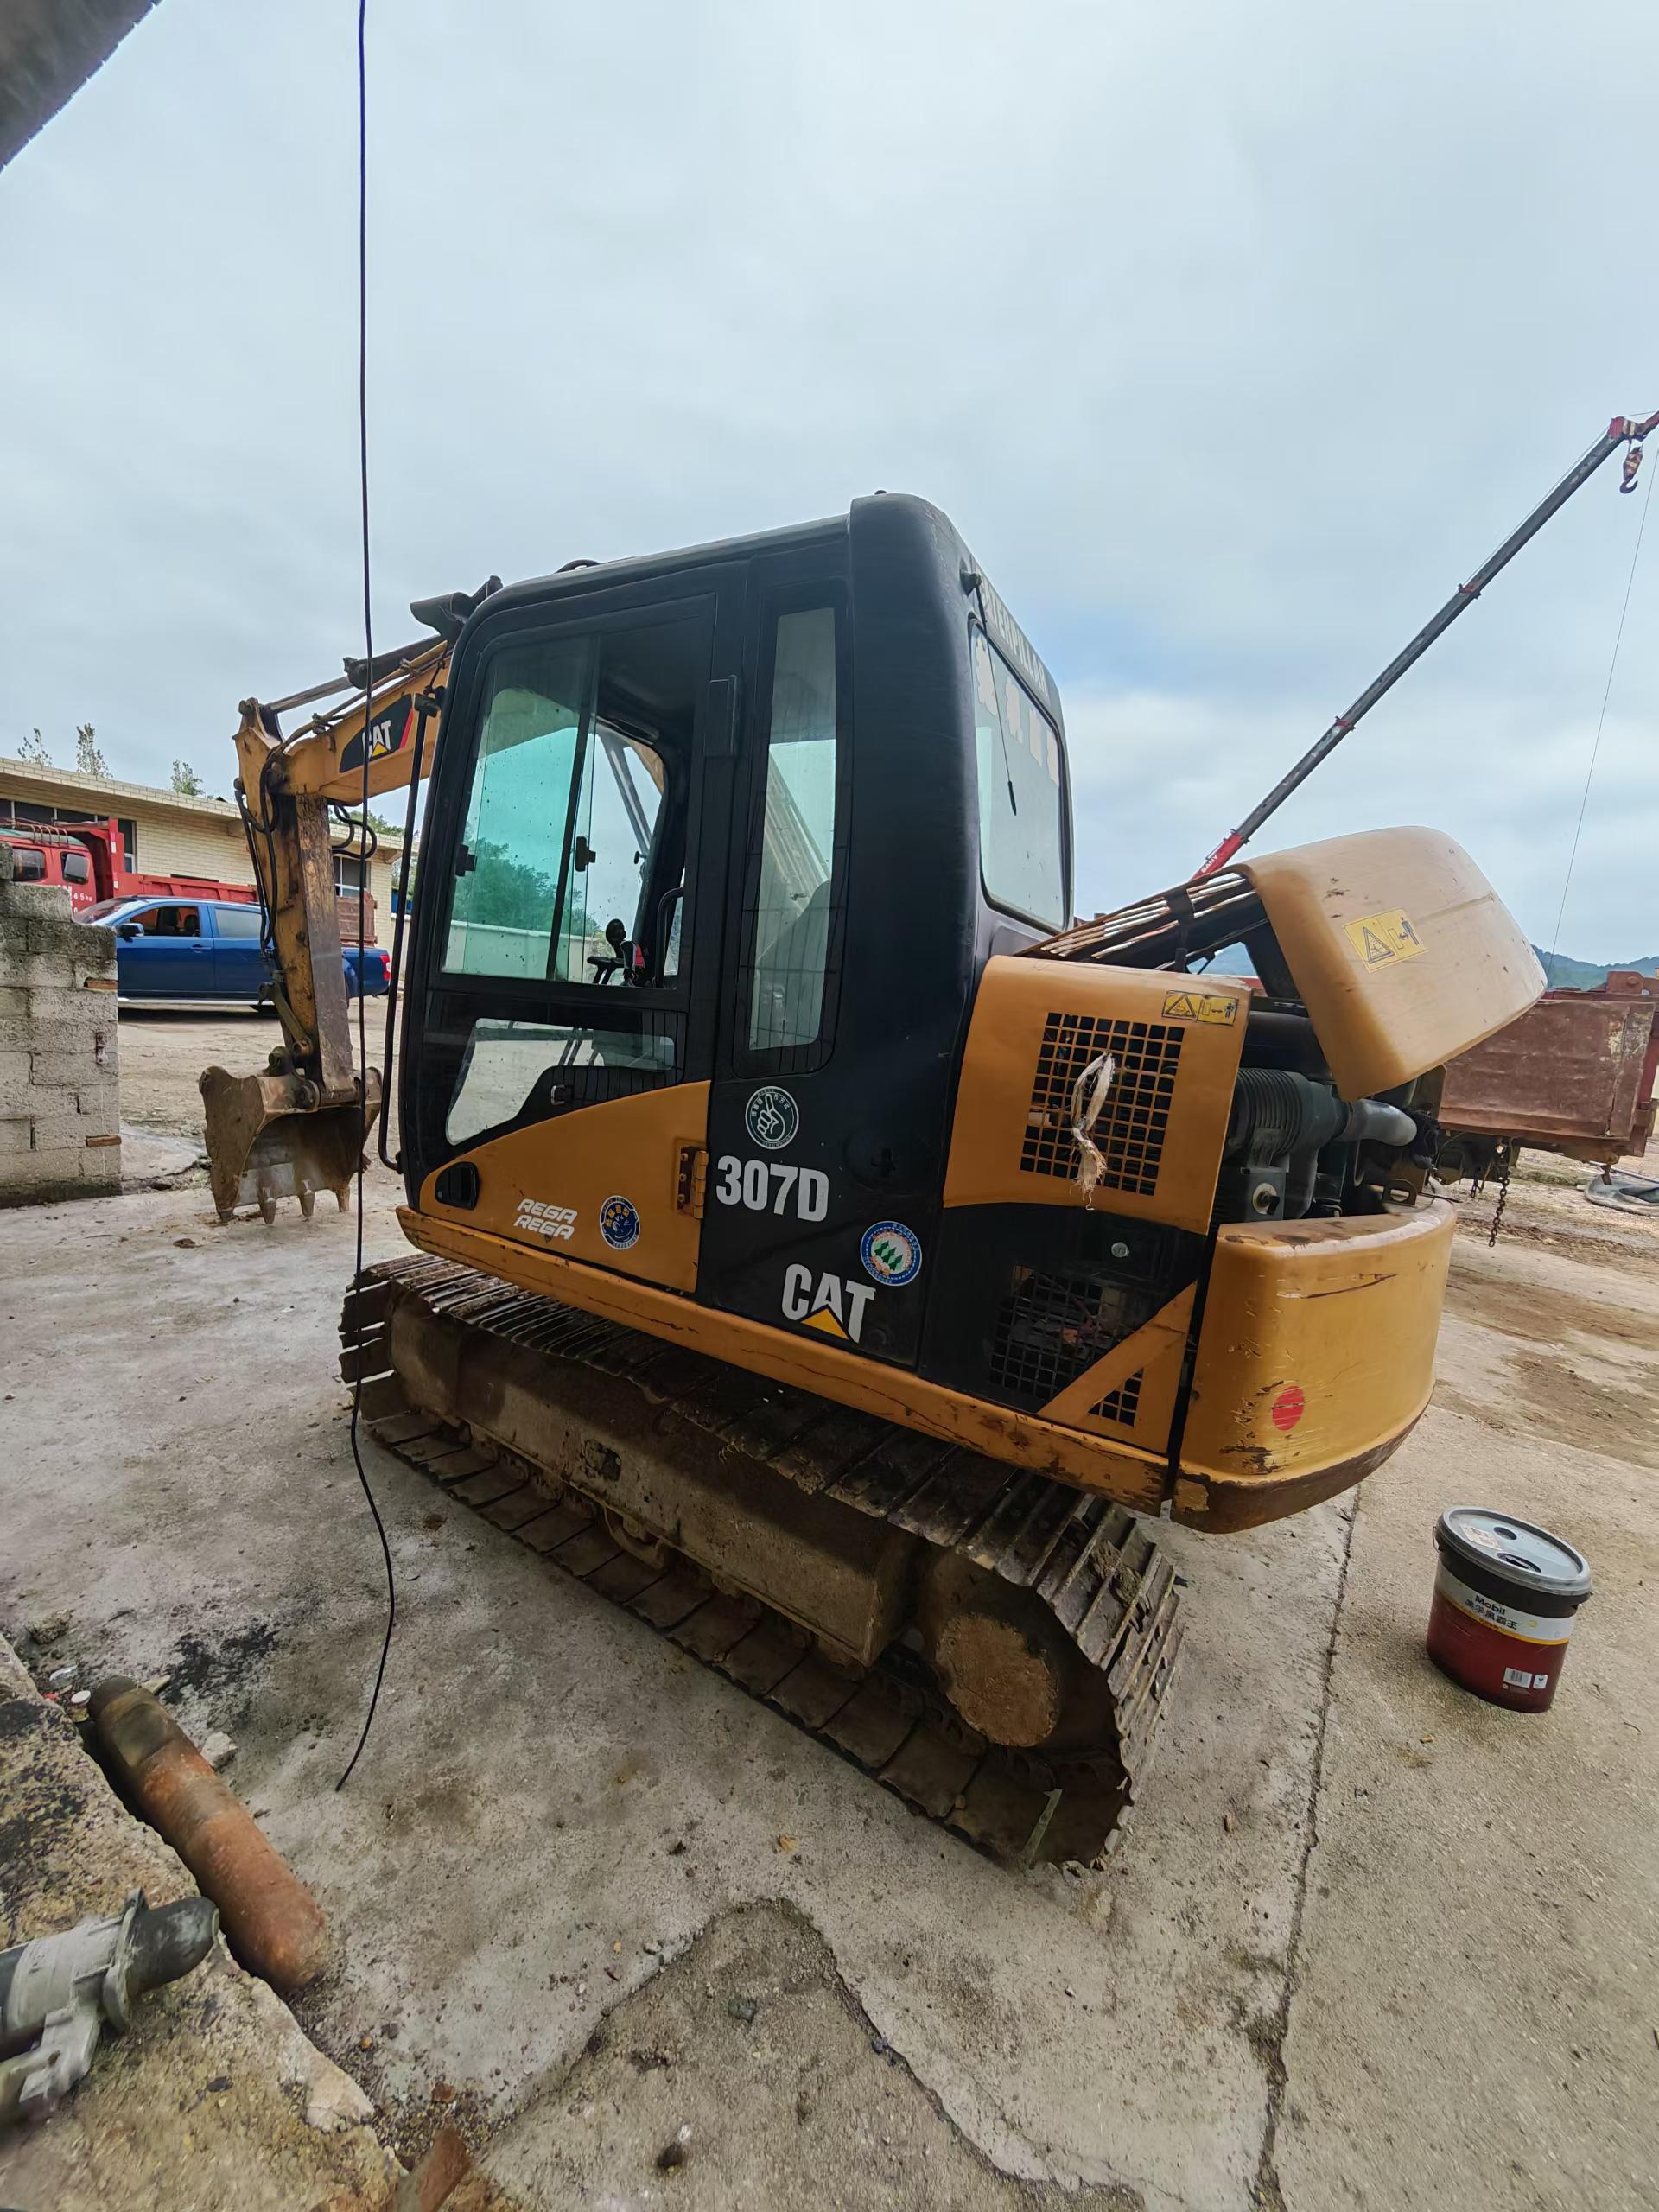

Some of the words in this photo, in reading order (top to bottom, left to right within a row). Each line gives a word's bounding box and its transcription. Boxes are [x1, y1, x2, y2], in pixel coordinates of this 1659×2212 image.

[1201, 855, 1217, 873] SANY
[716, 1155, 830, 1222] 307D
[517, 1198, 578, 1224] REGA
[513, 1214, 575, 1240] REGA
[781, 1263, 876, 1344] CAT
[1465, 1599, 1518, 1630] 美孚黑霸王
[1475, 1595, 1506, 1615] Mobil
